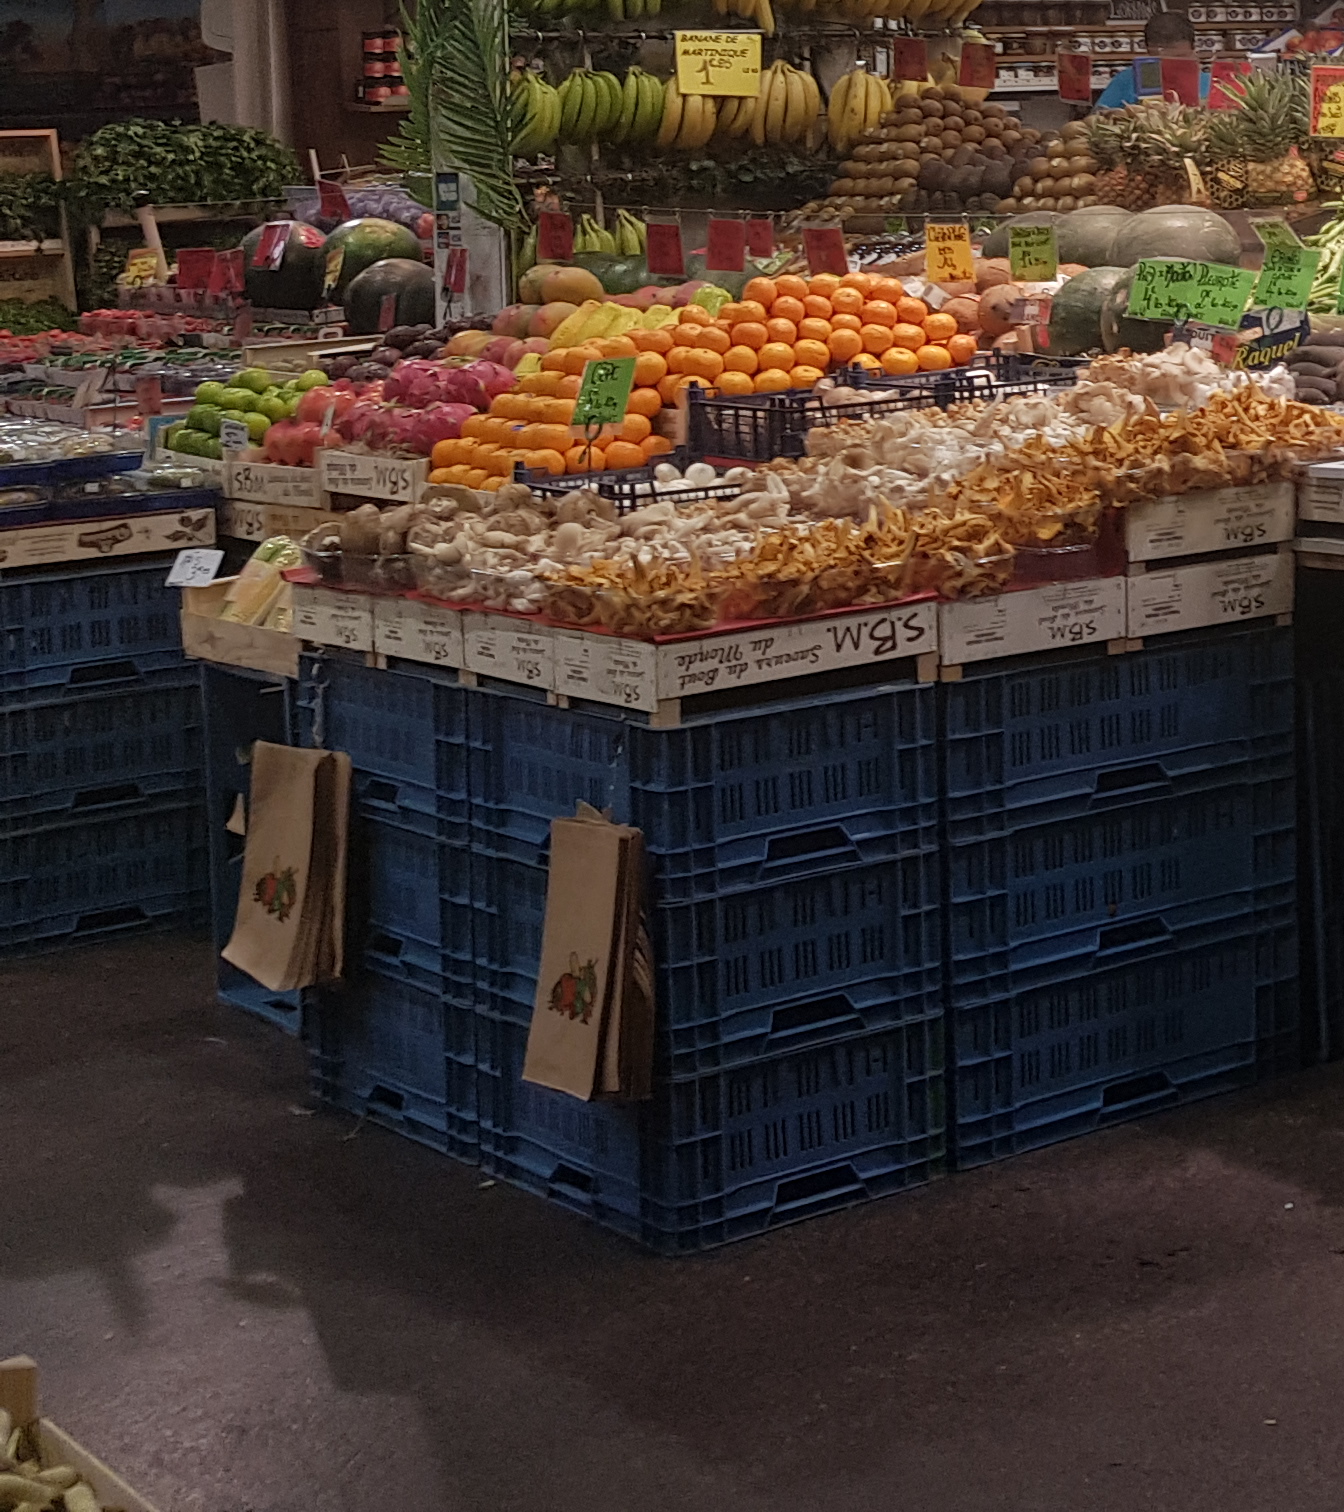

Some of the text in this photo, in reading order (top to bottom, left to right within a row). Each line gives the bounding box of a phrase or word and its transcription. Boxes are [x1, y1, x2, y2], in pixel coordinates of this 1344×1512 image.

[681, 34, 739, 44] BANANE DE
[681, 48, 749, 59] MARTINIQUE
[1232, 332, 1300, 370] Raquel
[676, 643, 743, 671] Monde
